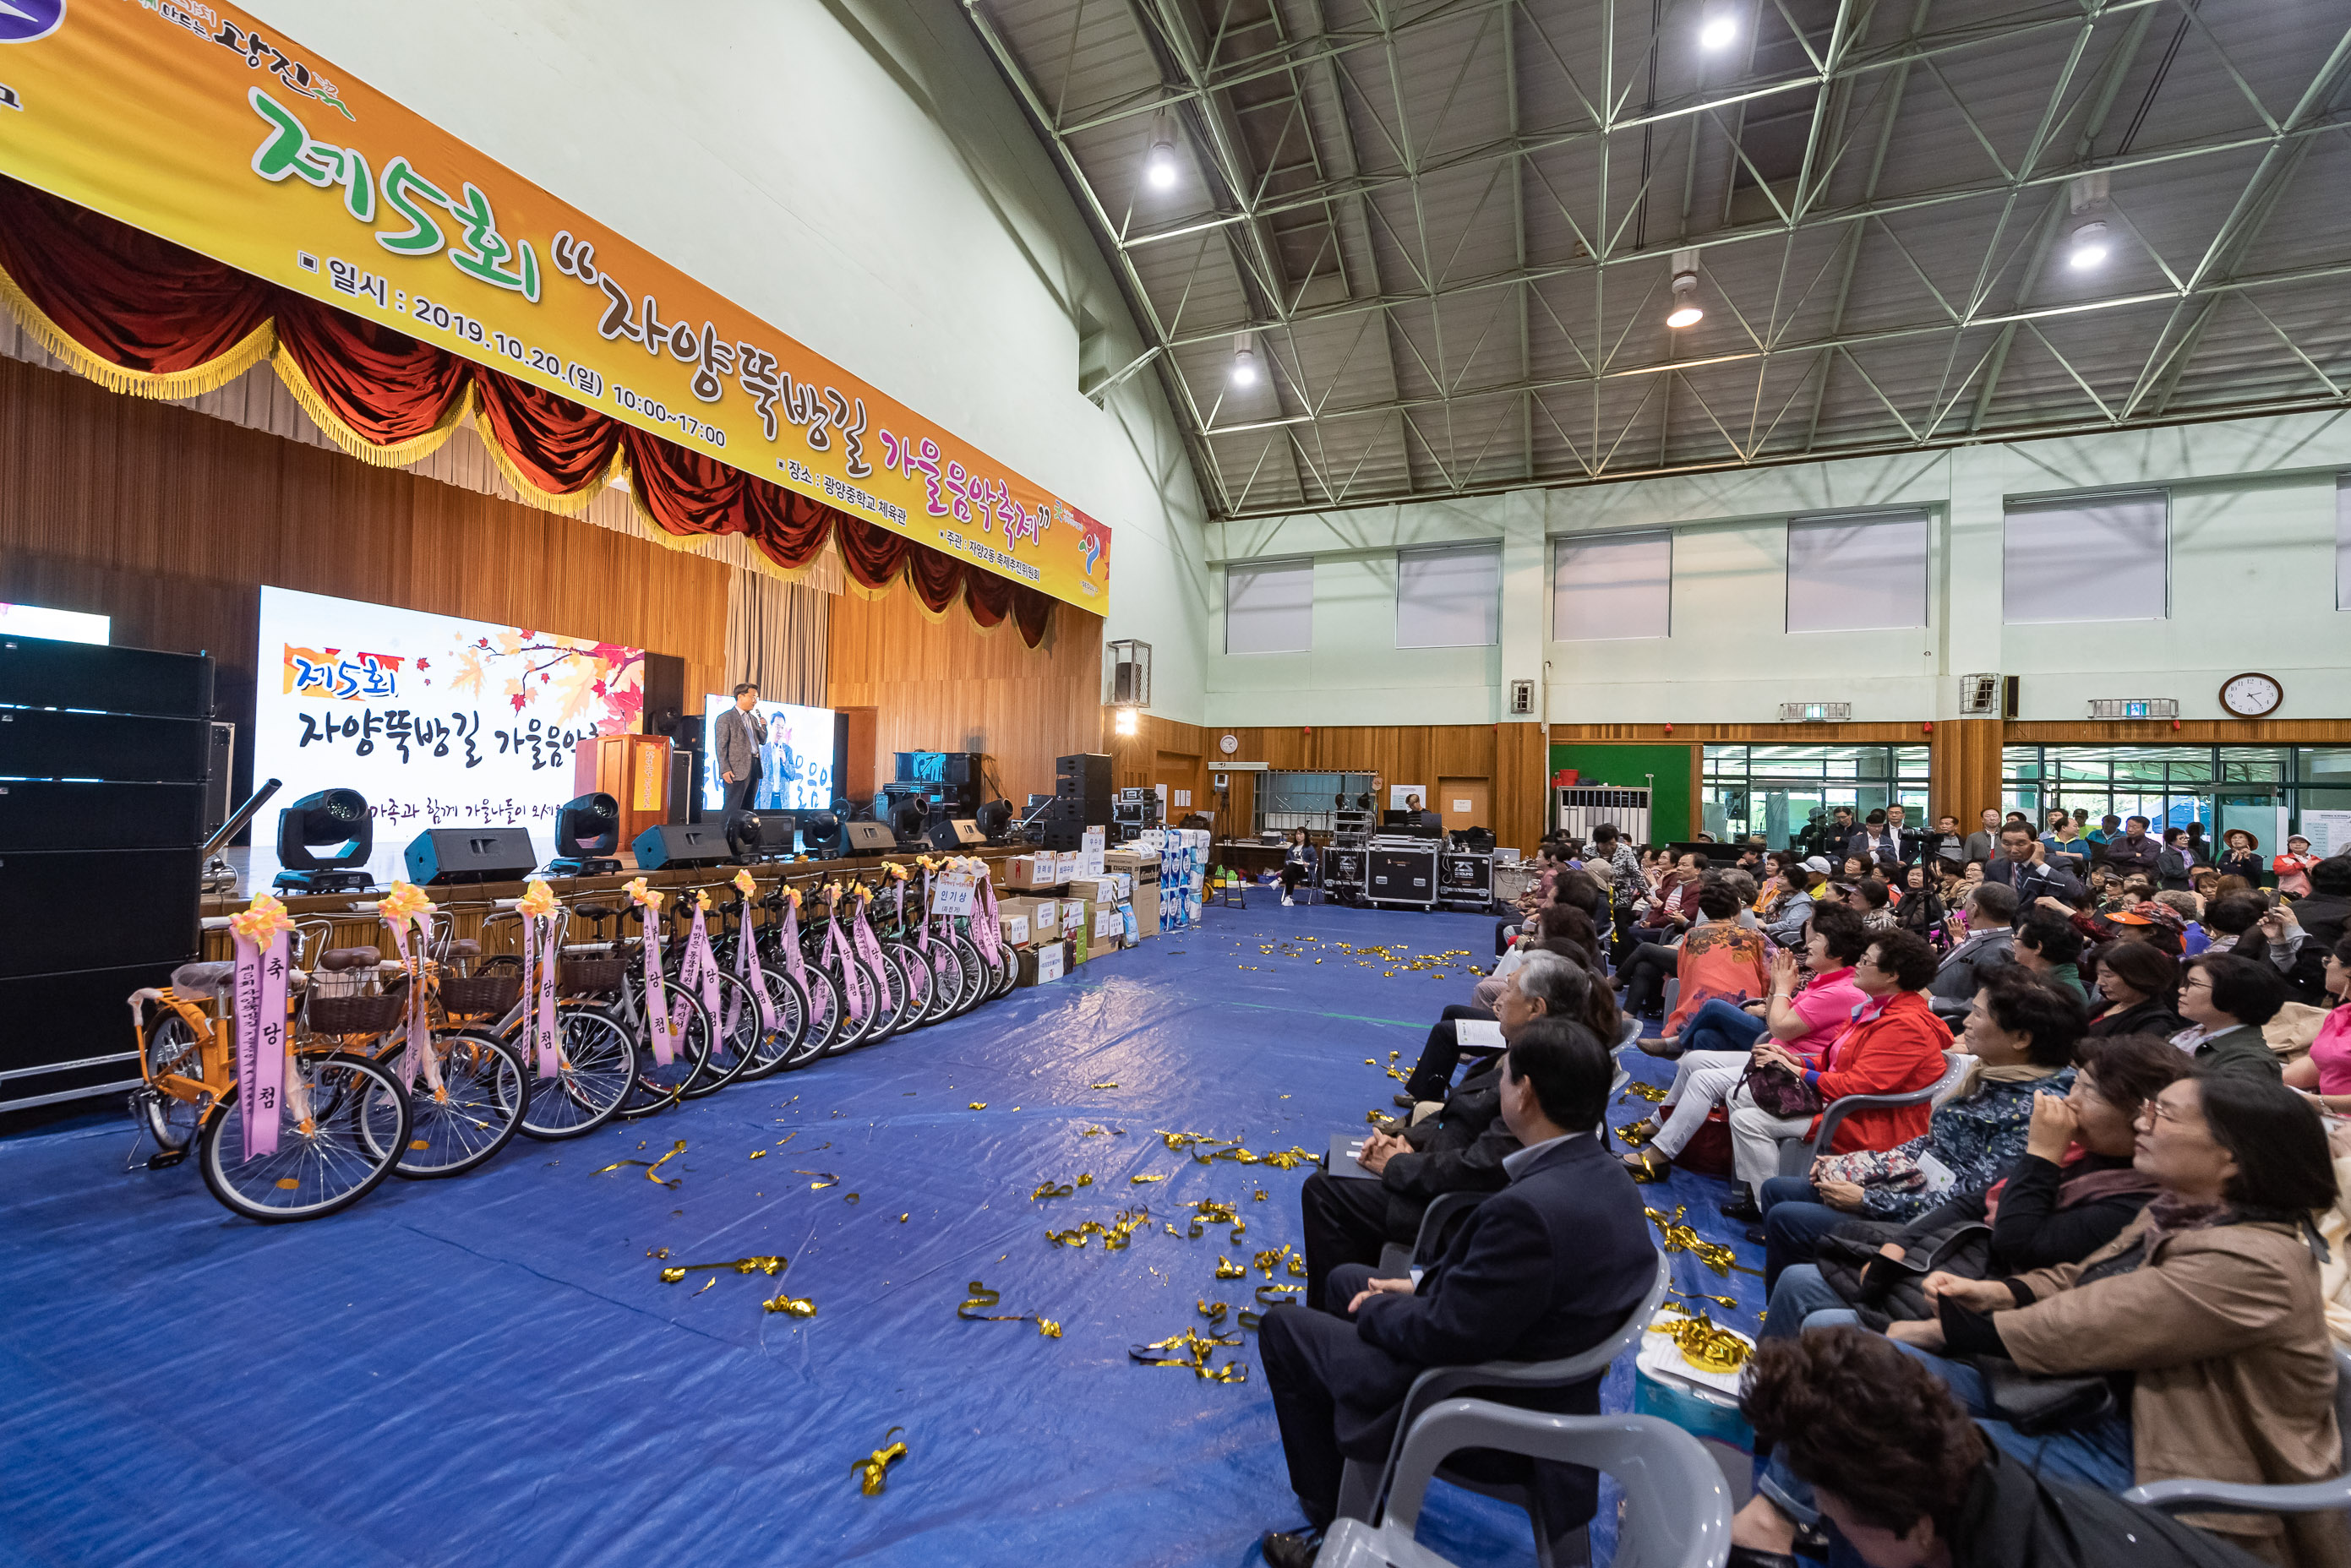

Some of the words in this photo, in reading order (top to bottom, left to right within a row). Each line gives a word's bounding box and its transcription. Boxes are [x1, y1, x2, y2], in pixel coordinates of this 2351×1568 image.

[161, 3, 212, 41] 만드는
[215, 20, 317, 99] 광진
[252, 90, 541, 301] 제5회
[330, 259, 385, 305] 일시
[614, 386, 725, 447] 10:00~17:00
[788, 460, 813, 484] 장소
[823, 477, 876, 510] 광양중학교
[878, 499, 908, 525] 체육관
[946, 531, 963, 548] 주관
[968, 540, 995, 564] 자양2동
[996, 553, 1040, 581] 축제추진위원회
[296, 657, 397, 698] 제5회
[299, 708, 483, 768] 자양뚝방길
[427, 797, 458, 825] 함께
[466, 798, 526, 825] 가을나들이
[941, 890, 967, 903] 인기상
